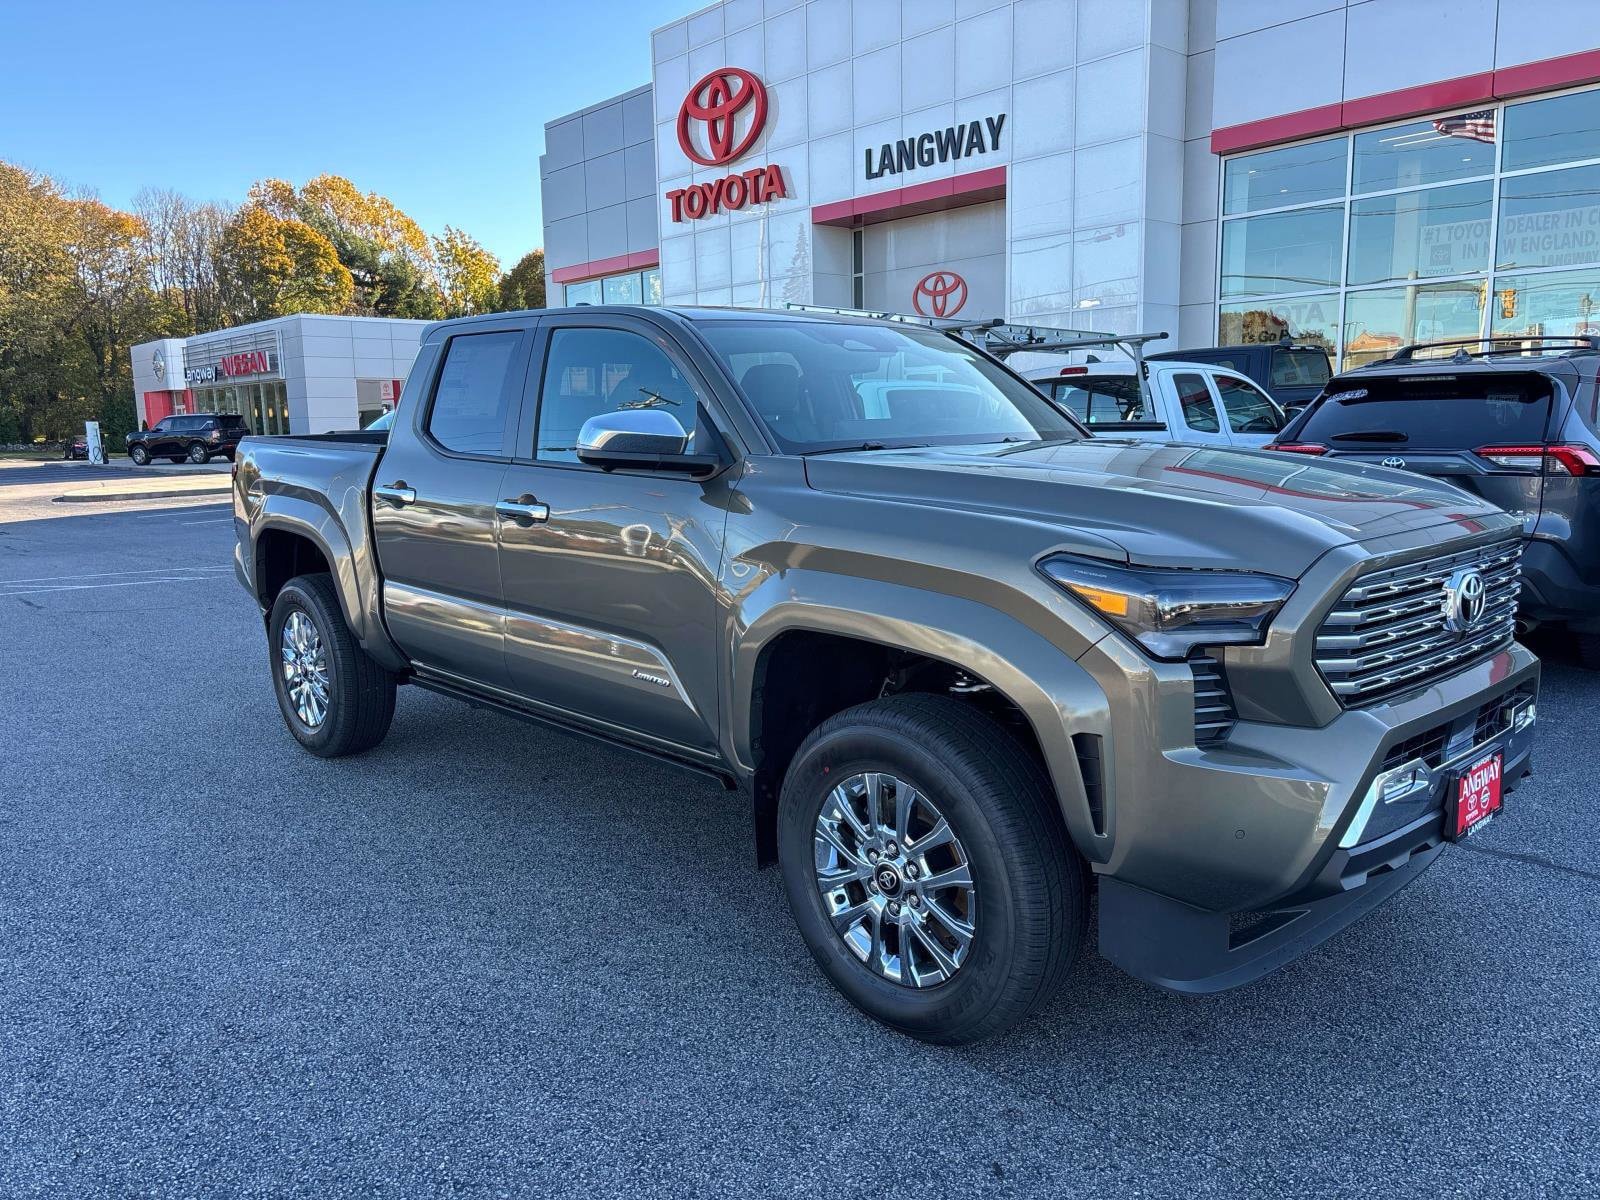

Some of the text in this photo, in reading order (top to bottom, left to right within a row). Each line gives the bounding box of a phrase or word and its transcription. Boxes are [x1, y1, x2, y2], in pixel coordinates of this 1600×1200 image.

[865, 114, 1006, 180] LANGWAY
[666, 164, 787, 223] TOYOTA
[1423, 206, 1600, 245] #1 TOYOT DEALER IN C
[1462, 229, 1599, 260] IN NW ENGLAND.
[1258, 330, 1277, 343] Go
[184, 351, 270, 384] Langway NISSAN
[1459, 759, 1501, 802] ANGWAY
